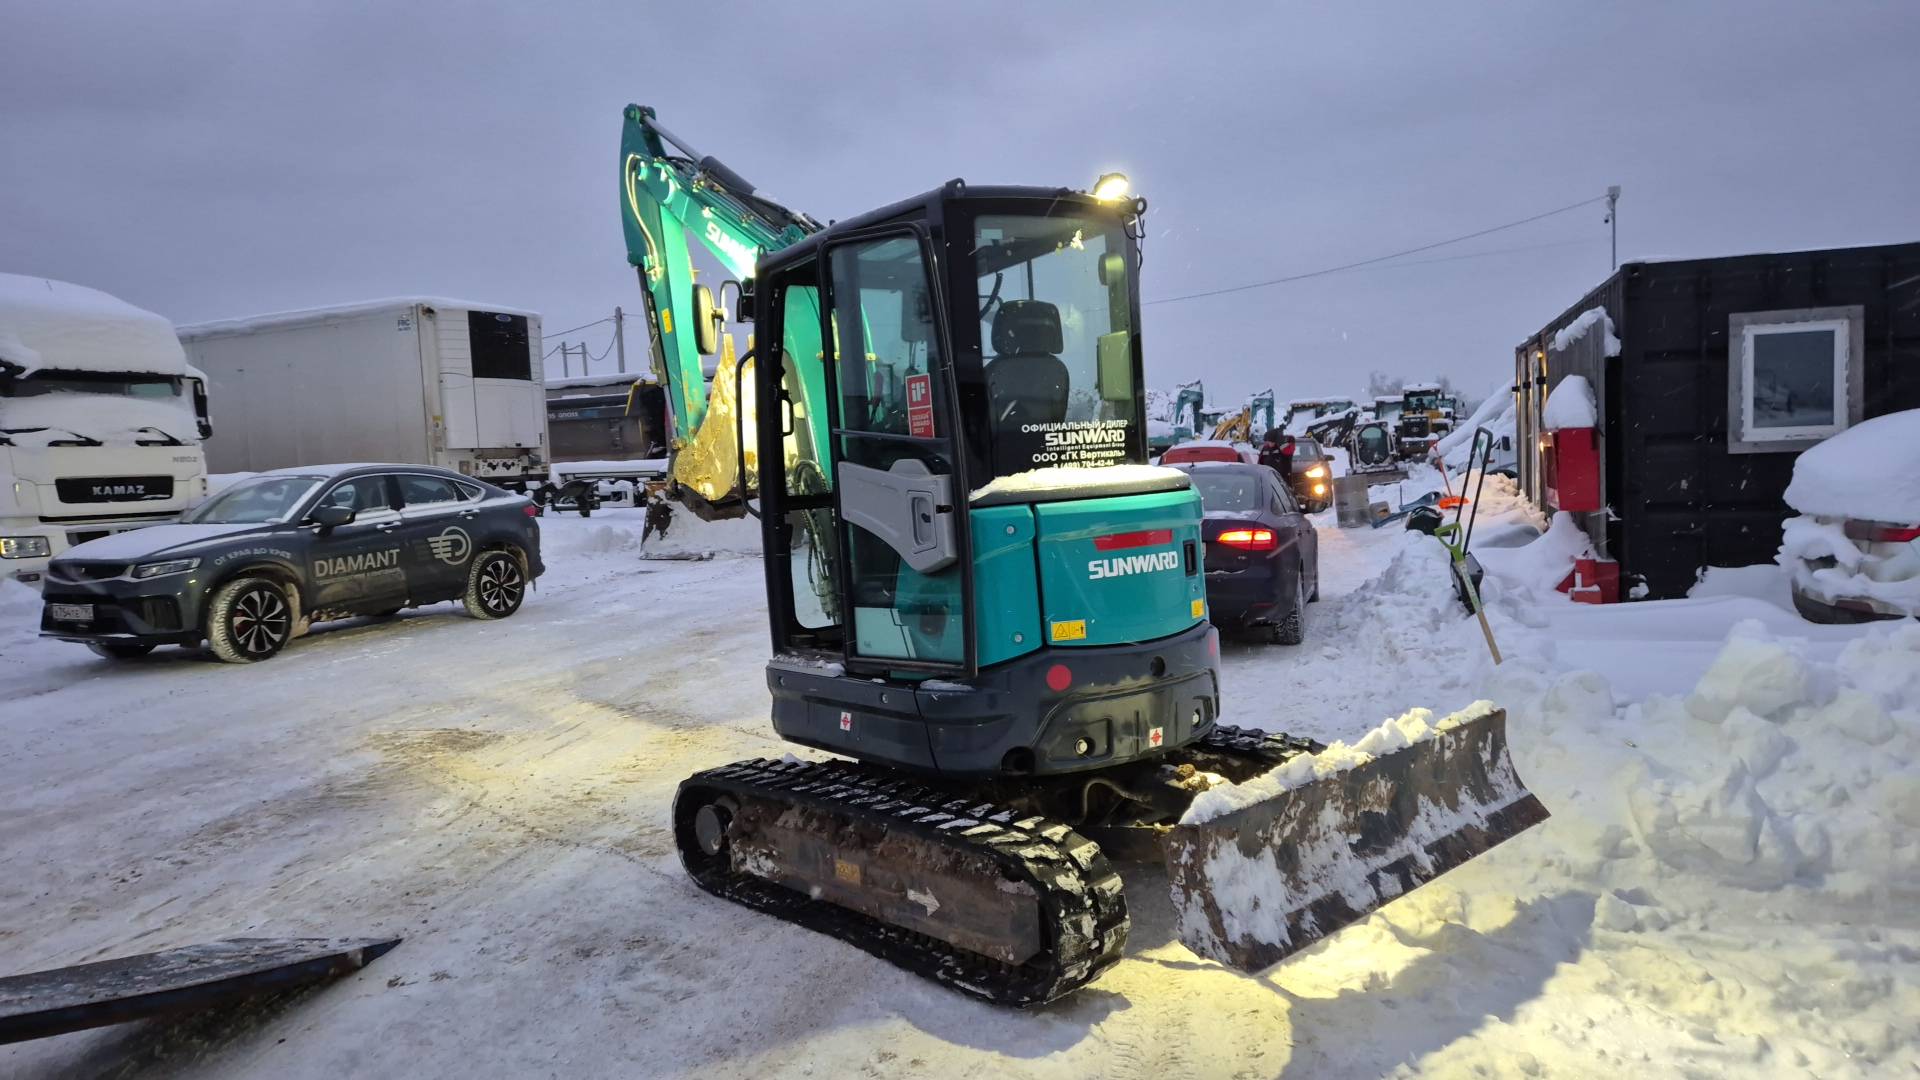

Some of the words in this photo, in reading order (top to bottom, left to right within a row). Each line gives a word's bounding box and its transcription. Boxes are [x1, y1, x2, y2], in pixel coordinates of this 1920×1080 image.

[1021, 419, 1101, 433] ОФИЦИАЛЬНЫЙ
[1105, 419, 1128, 430] ДИЛЕР
[1044, 429, 1126, 446] SUNWARD
[1046, 444, 1081, 452] Intelligent
[1081, 443, 1111, 451] Equipment
[1032, 452, 1058, 463] ООО
[1079, 449, 1126, 461] Вертикаль»
[92, 485, 145, 496] KAMAZ
[313, 549, 400, 577] DIAMANT
[1088, 551, 1178, 579] SUNWARD
